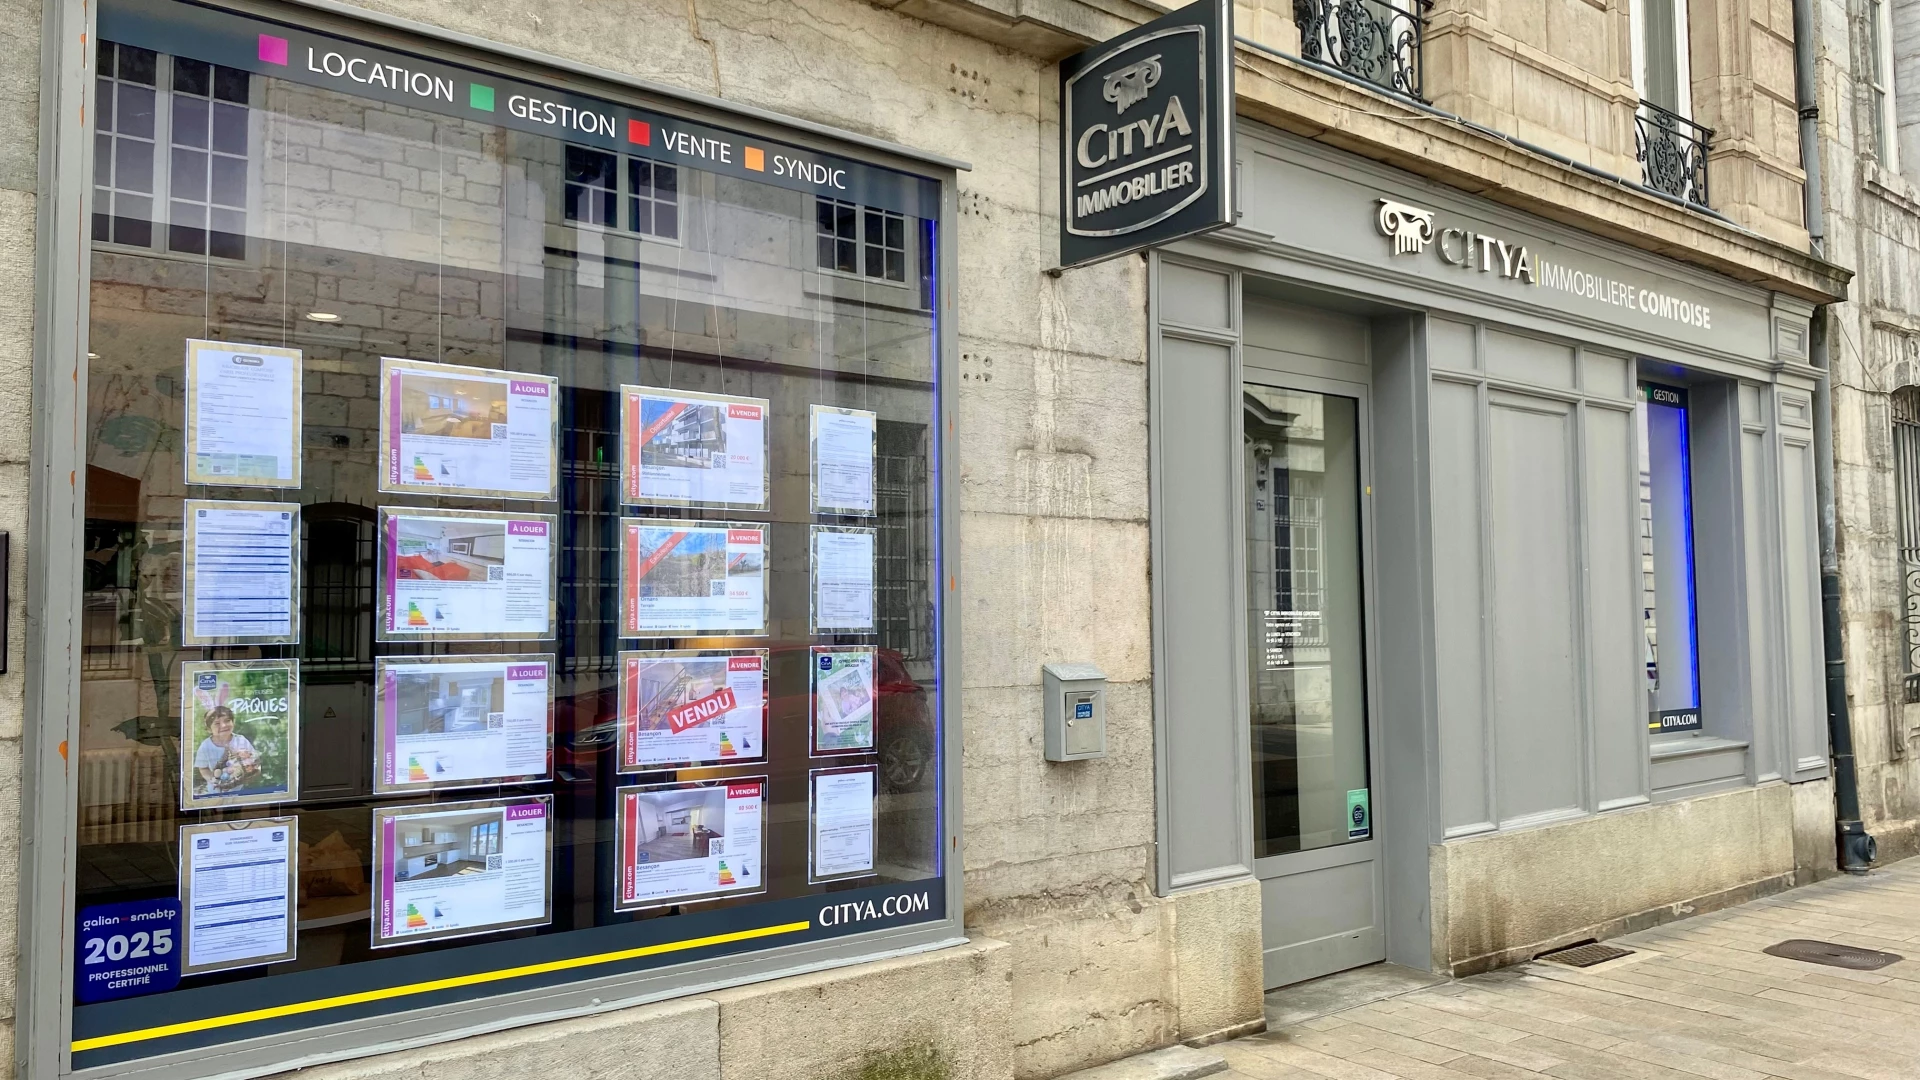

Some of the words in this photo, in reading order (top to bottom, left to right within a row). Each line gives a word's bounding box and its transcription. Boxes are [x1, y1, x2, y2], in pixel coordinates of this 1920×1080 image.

[307, 46, 454, 103] LOCATION
[508, 95, 617, 139] GESTION
[661, 129, 732, 164] VENTE
[773, 155, 847, 190] SYNDIC
[1077, 161, 1194, 218] IMMOBILIER
[1436, 227, 1535, 284] CITYA
[1540, 260, 1637, 310] IMMOBILIERE
[1639, 289, 1712, 330] COMTOISE
[515, 383, 521, 392] À
[522, 385, 546, 394] LOUER
[1653, 389, 1679, 404] GESTION
[390, 448, 398, 485] citya.com
[513, 524, 519, 532] À
[520, 525, 544, 533] LOUER
[512, 669, 518, 677] À
[519, 669, 543, 678] LOUER
[731, 661, 736, 669] À
[228, 697, 288, 715] PÂQUES
[671, 693, 731, 729] VENDU
[1662, 714, 1698, 728] CITYA.COM
[729, 788, 735, 796] À
[735, 787, 759, 795] VENDRE
[511, 809, 517, 818] À
[518, 808, 542, 817] LOUER
[382, 899, 391, 937] citya.com
[818, 891, 930, 927] CITYA.COM
[83, 915, 120, 932] galian
[130, 909, 176, 922] smabtp
[84, 929, 173, 965] 2025
[89, 963, 169, 982] PROFESSIONNEL
[108, 974, 151, 989] CERTIFIÉ
